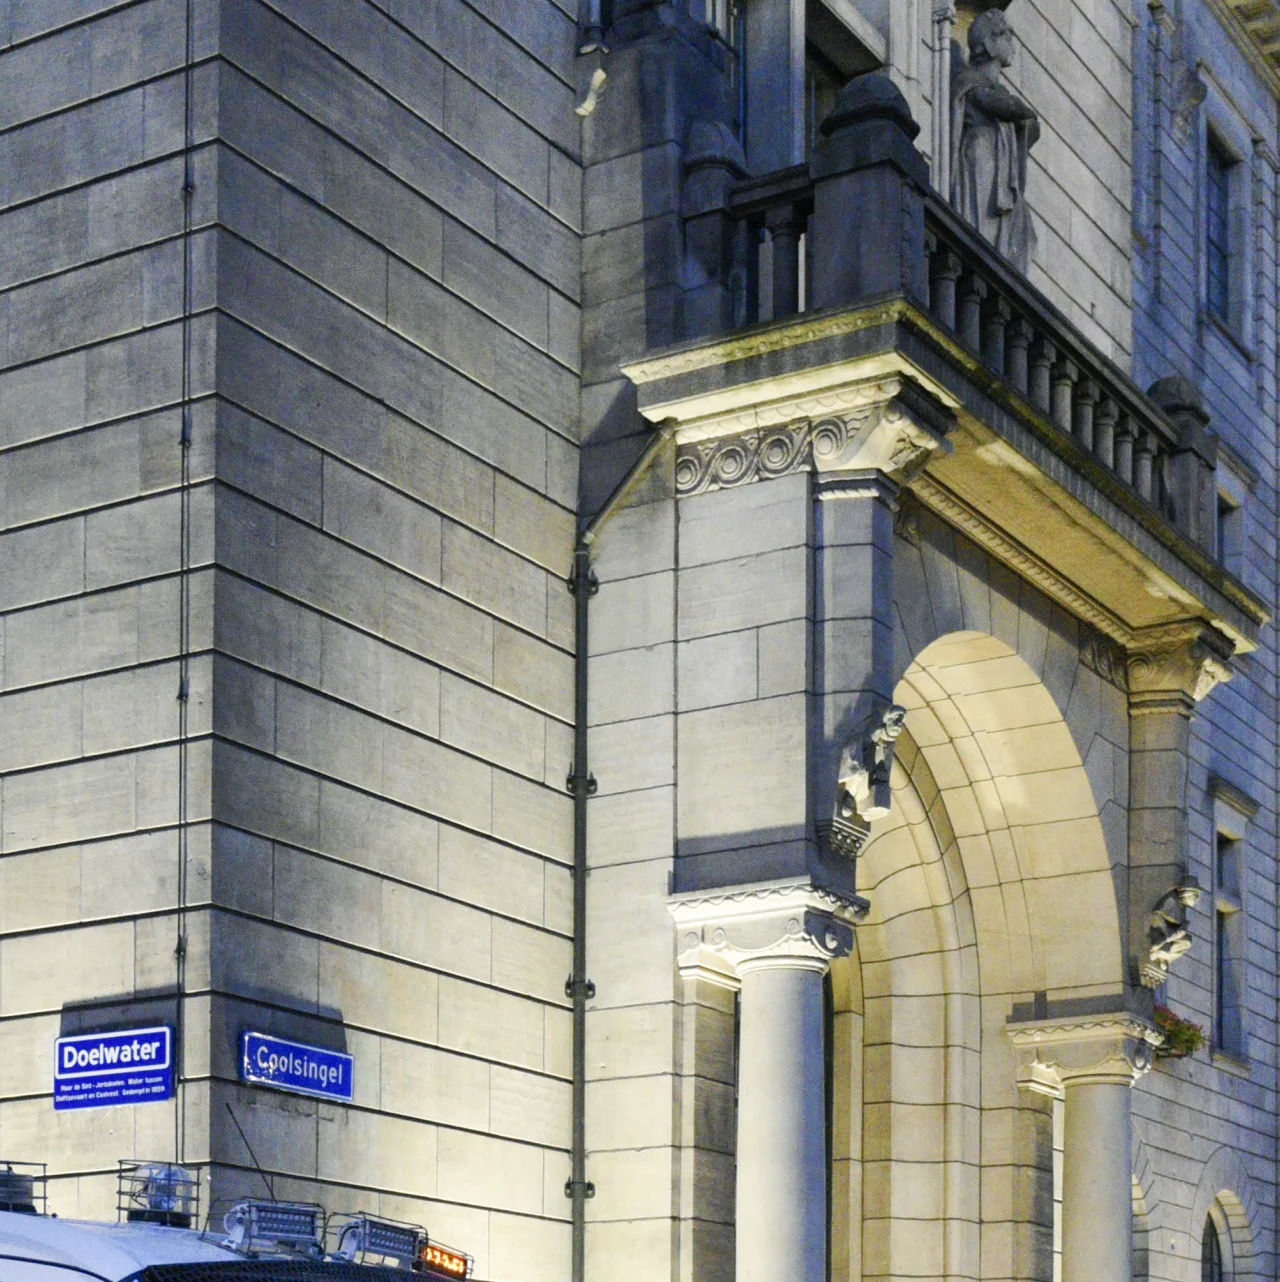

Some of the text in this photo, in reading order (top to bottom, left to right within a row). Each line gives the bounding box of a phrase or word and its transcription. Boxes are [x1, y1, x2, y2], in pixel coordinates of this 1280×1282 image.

[63, 1039, 161, 1068] Doelwater
[257, 1046, 343, 1088] Coolsingel
[127, 1077, 144, 1086] Water
